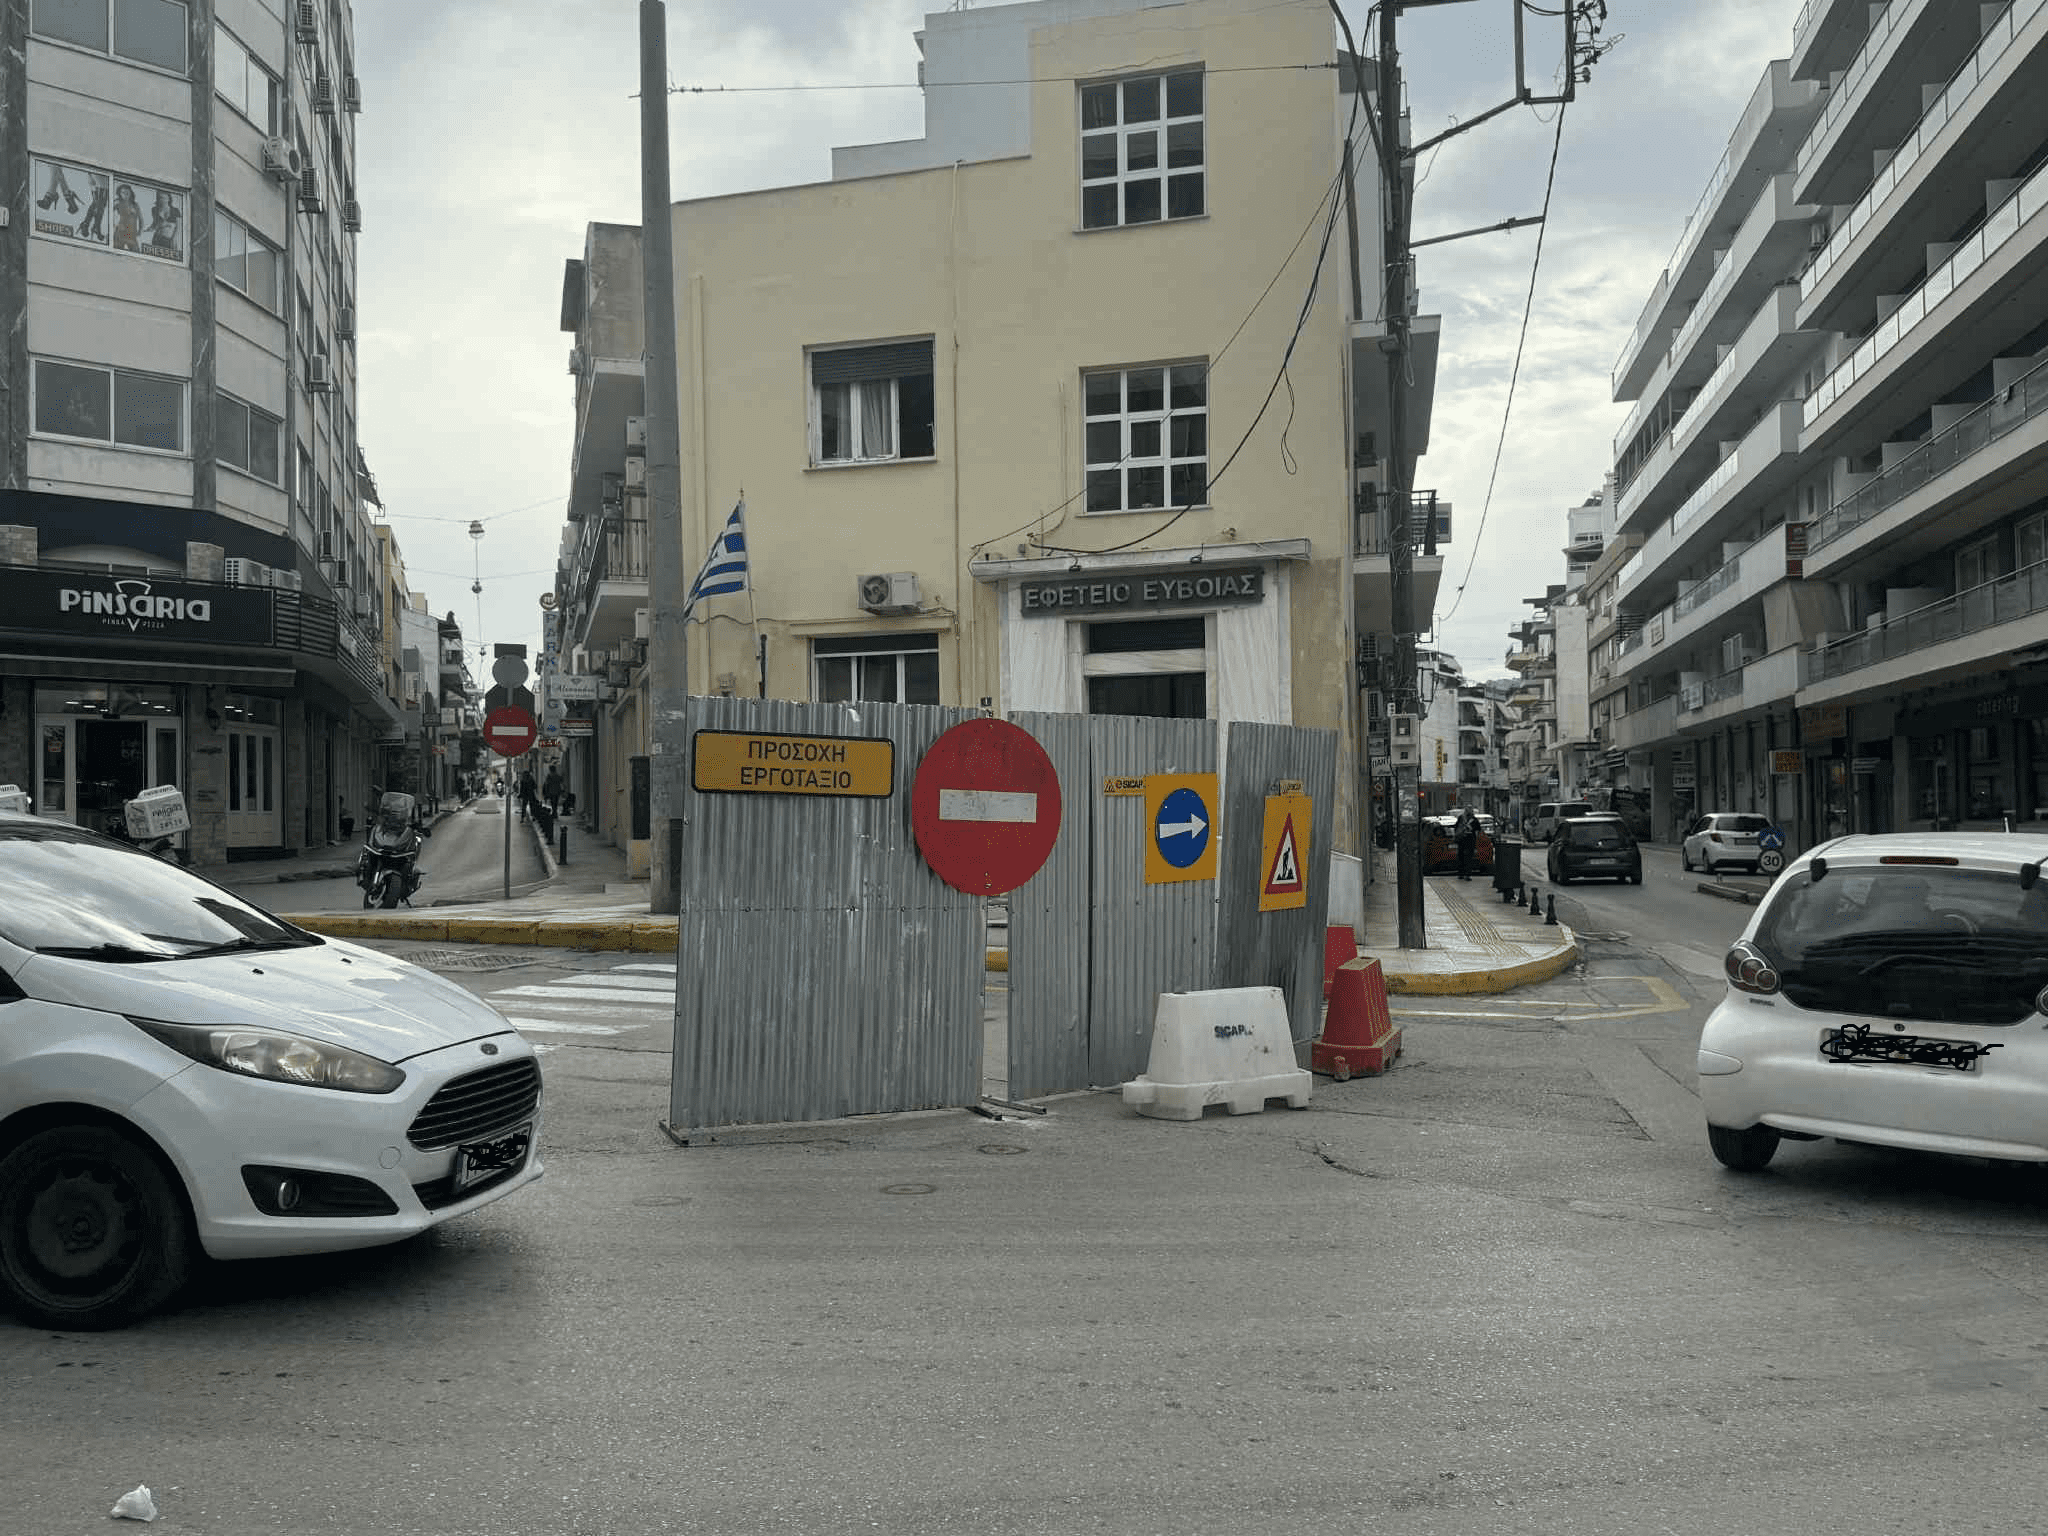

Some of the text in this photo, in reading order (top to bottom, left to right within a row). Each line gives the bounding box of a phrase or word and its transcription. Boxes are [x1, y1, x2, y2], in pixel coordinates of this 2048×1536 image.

[38, 221, 72, 236] SHOES
[1024, 573, 1256, 608] ΕΦΕΤΕΙΟ ΕΥΒΟΙΑΣ
[747, 740, 846, 762] ΠΡΟΣΟΧΗ
[740, 766, 852, 789] ΕΡΓΟΤΑΞΙΟ
[1763, 855, 1780, 867] 30
